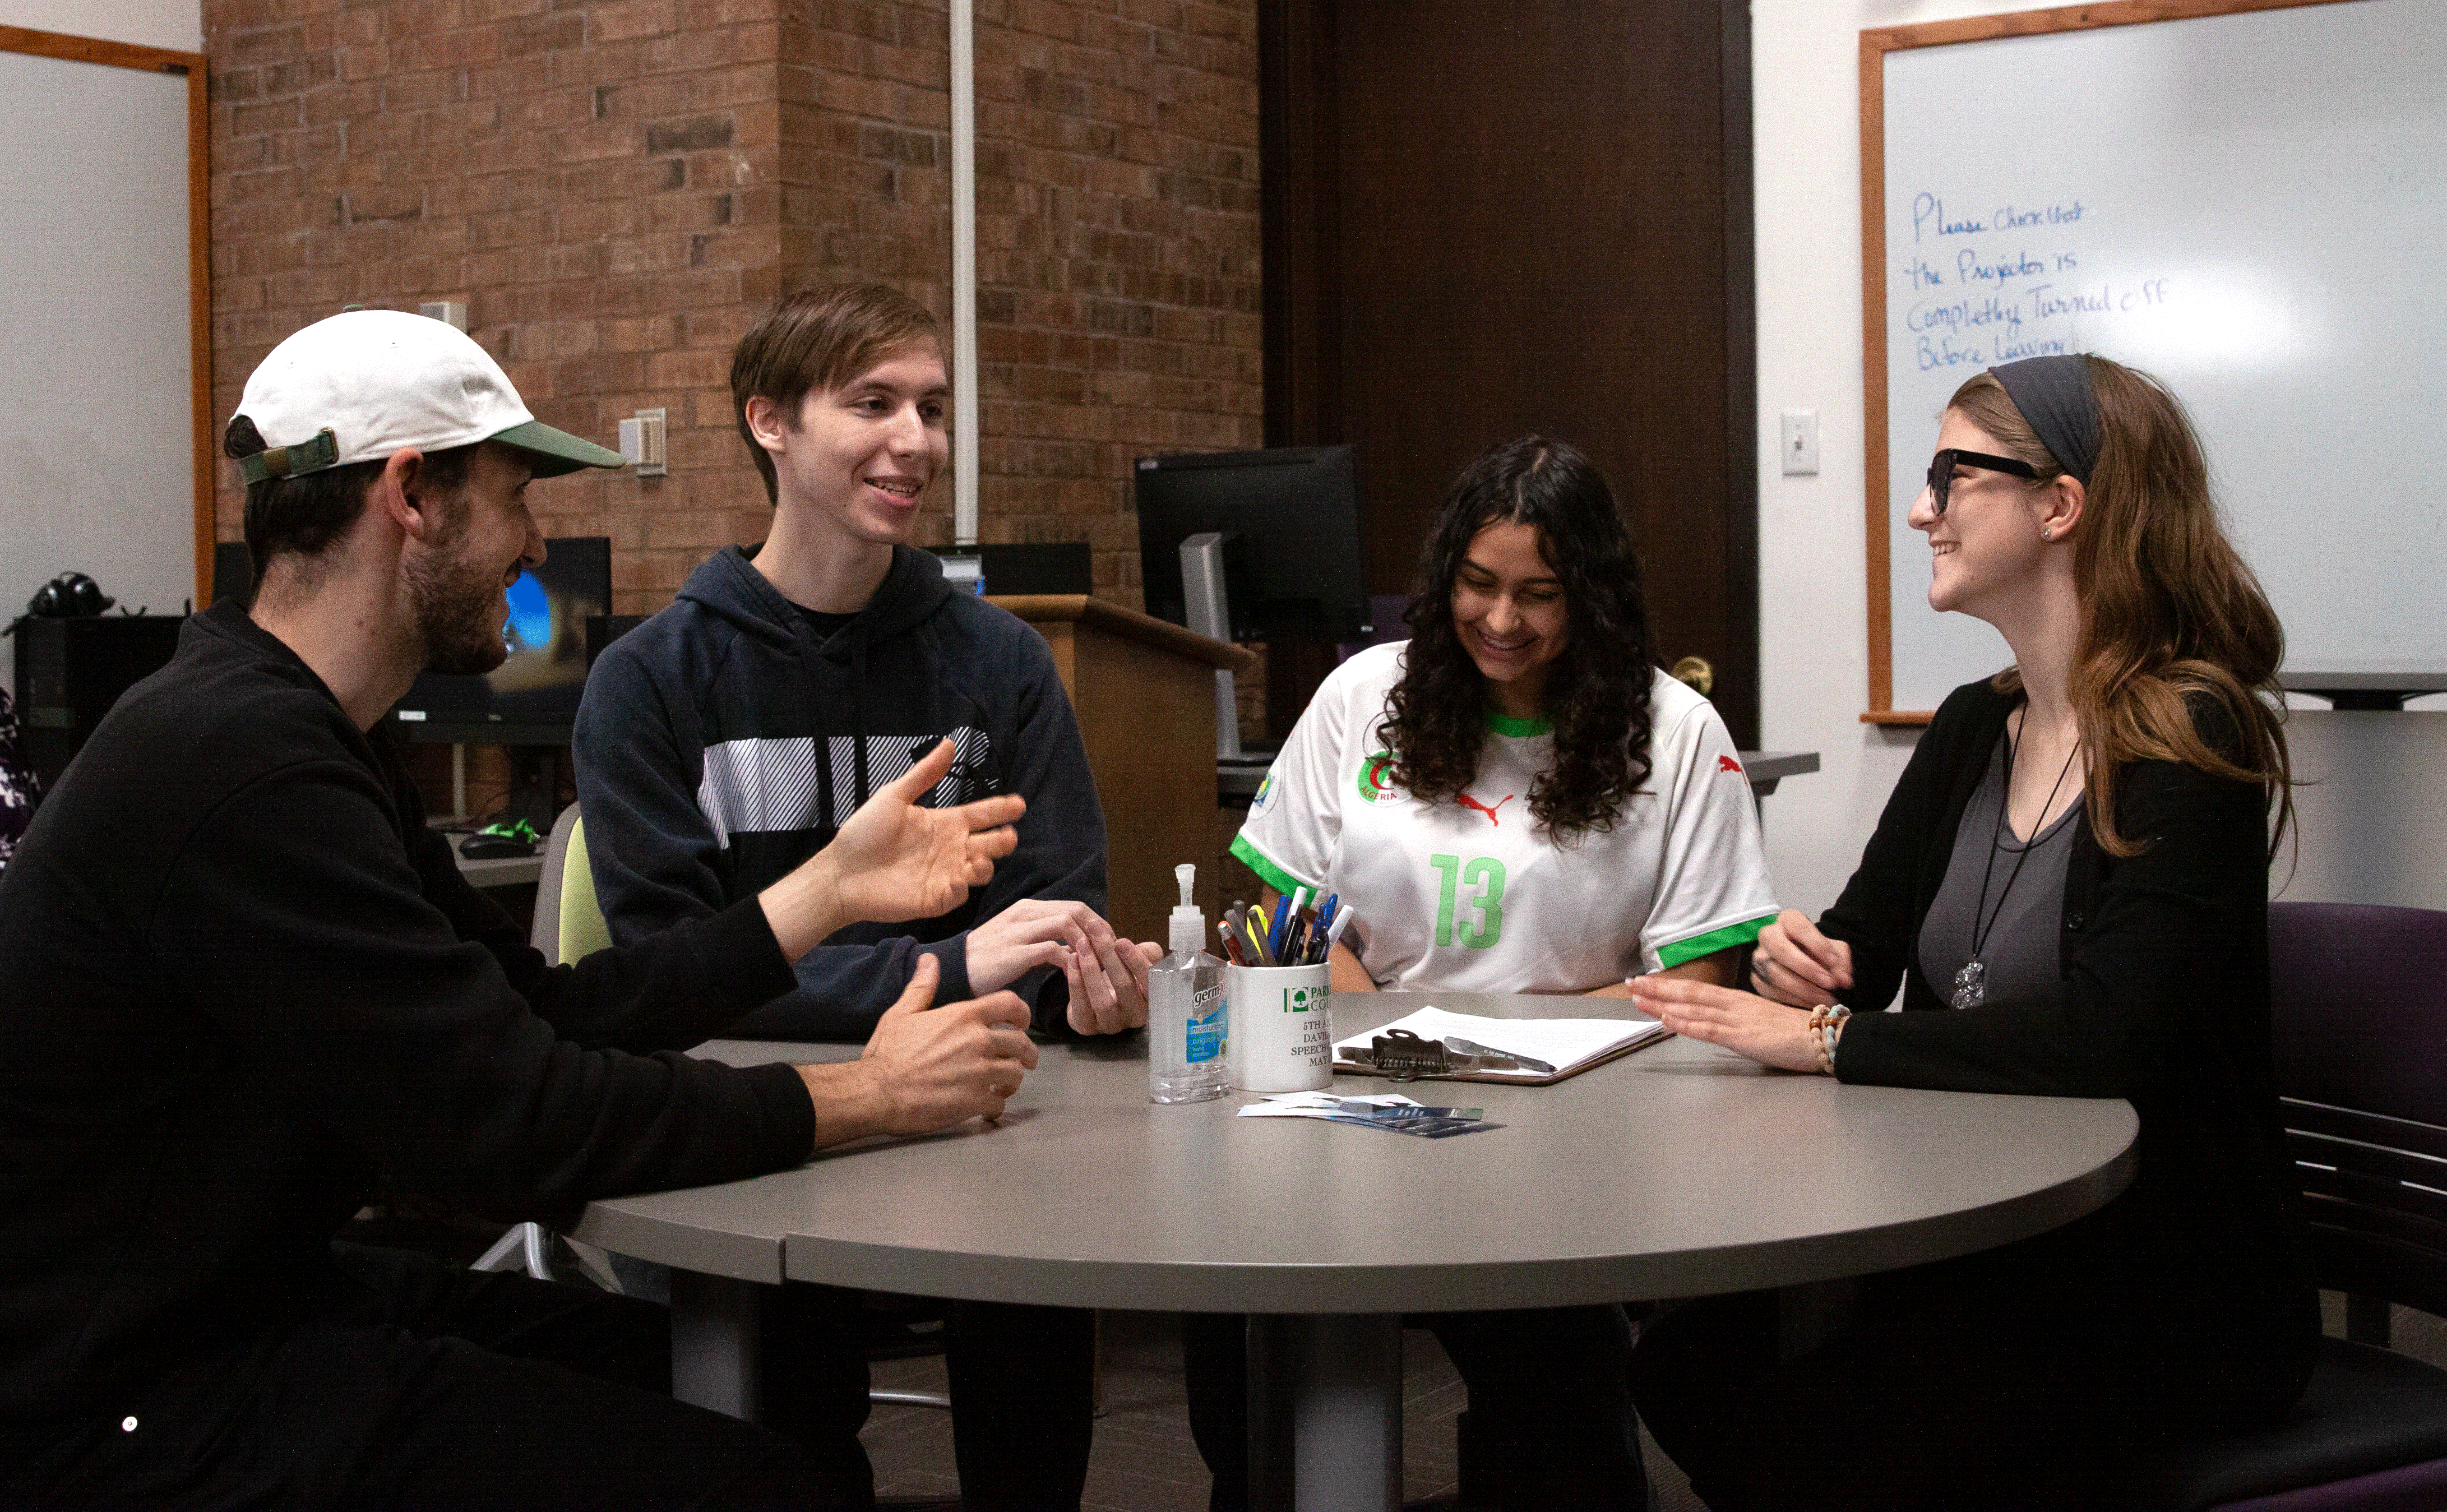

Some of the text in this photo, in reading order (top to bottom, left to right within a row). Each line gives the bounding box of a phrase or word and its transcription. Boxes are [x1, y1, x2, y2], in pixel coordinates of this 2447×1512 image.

[1913, 192, 1987, 243] Please
[2046, 201, 2084, 225] that
[1904, 248, 2078, 290] the Projector is
[2028, 284, 2111, 320] Turned
[1918, 334, 1985, 372] Before
[1361, 786, 1397, 801] ALGERIA
[1430, 854, 1507, 950] 13
[1303, 1020, 1321, 1030] 5TH
[1291, 1043, 1325, 1056] SPEECH
[1310, 1057, 1327, 1067] MAY
